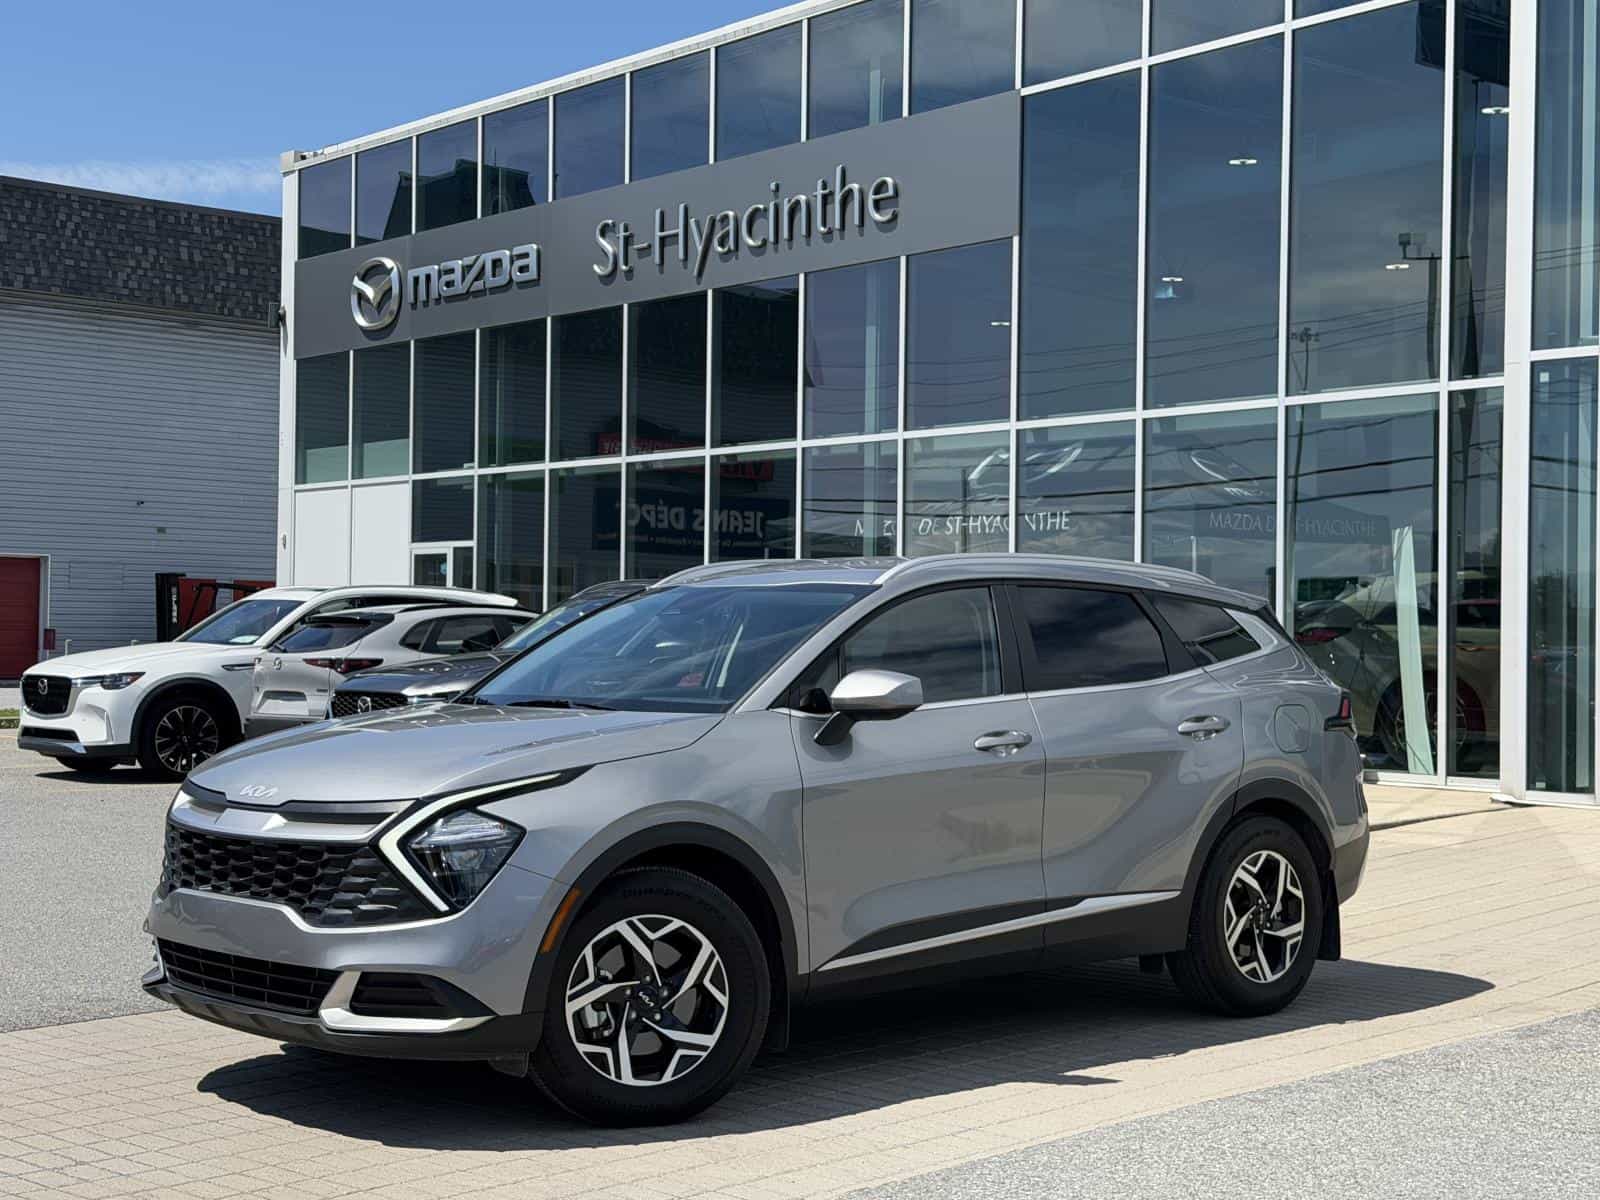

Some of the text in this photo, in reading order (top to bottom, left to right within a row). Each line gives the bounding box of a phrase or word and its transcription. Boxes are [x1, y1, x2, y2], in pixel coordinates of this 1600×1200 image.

[593, 165, 900, 277] St-Hyacinthe
[943, 510, 1071, 535] ST-HYACNTHE
[1208, 511, 1264, 532] MAZDA
